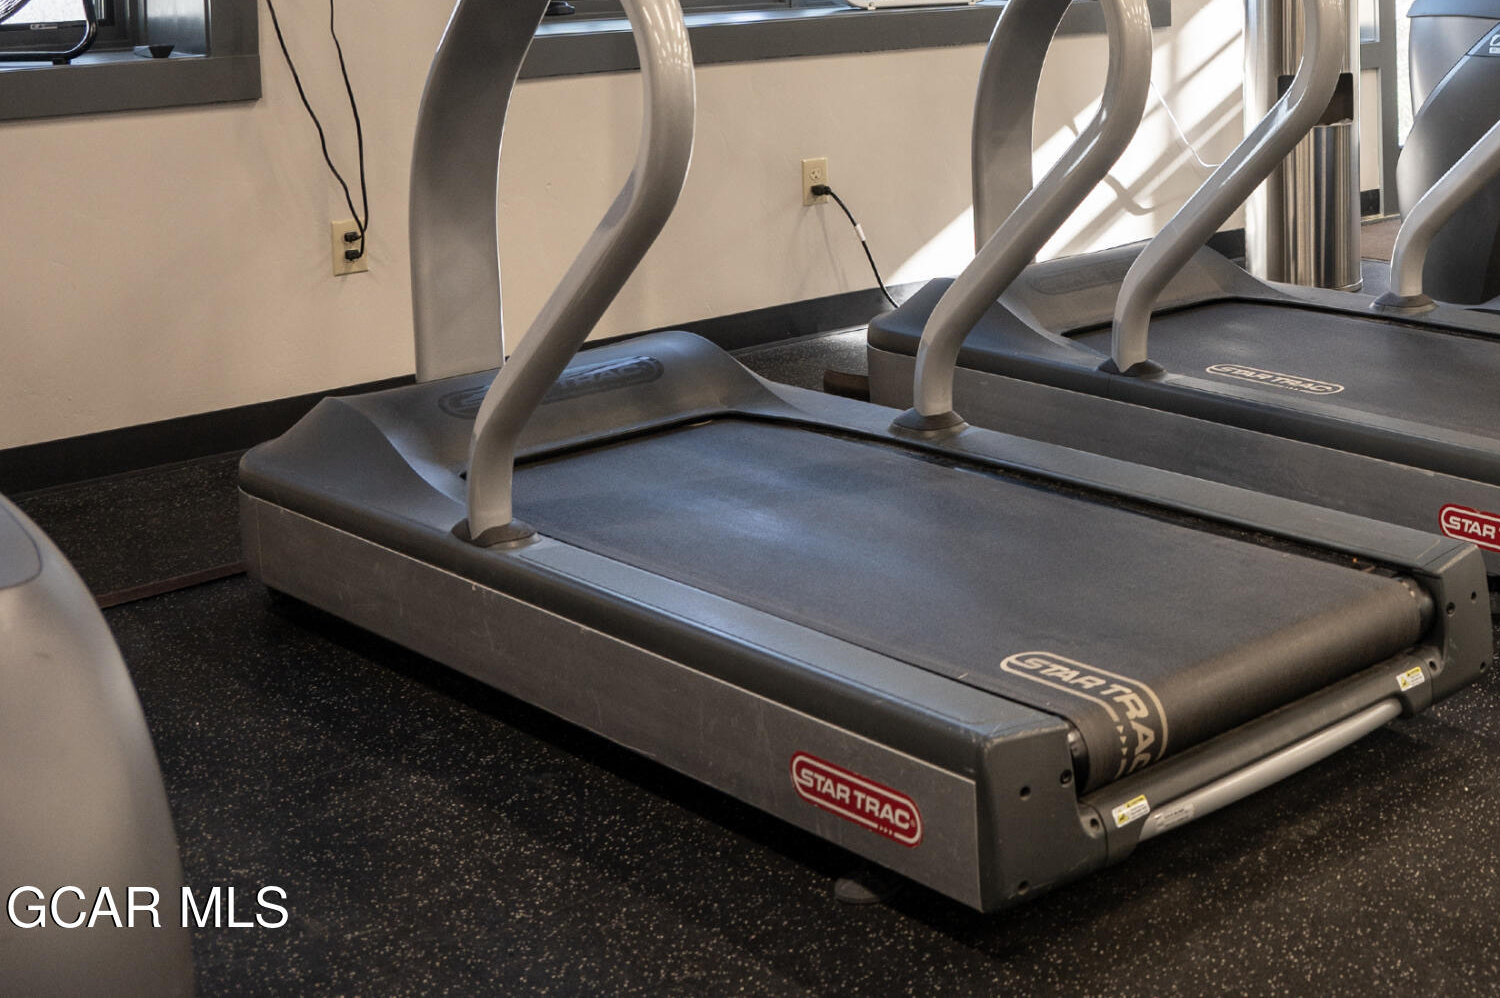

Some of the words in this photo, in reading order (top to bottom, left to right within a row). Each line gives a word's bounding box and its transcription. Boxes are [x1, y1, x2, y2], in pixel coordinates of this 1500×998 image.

[1216, 366, 1273, 380] STAR
[1271, 376, 1333, 391] TRAC
[1446, 515, 1496, 540] STAR
[1014, 657, 1106, 689] STAR
[798, 768, 851, 805] STAR
[853, 790, 911, 830] TRAC
